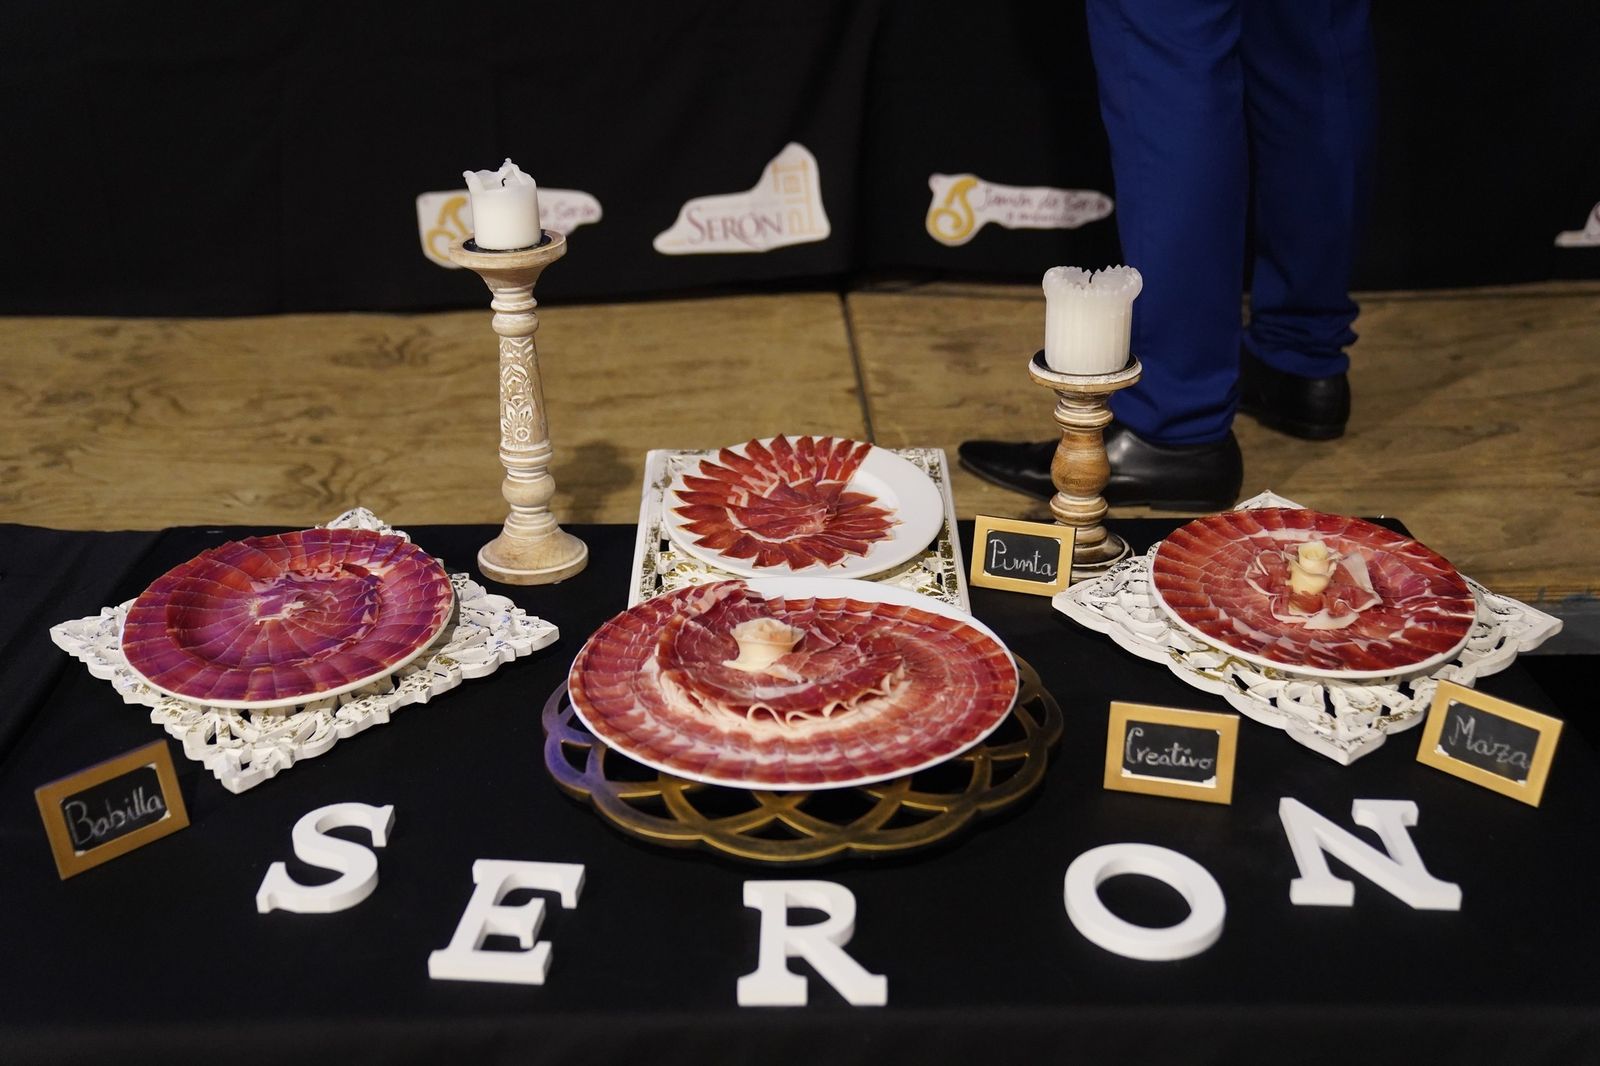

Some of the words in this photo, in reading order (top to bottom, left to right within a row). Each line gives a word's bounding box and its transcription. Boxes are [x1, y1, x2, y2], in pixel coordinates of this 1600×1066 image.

[989, 538, 1057, 577] Punta
[1125, 726, 1215, 770] Creativo
[65, 785, 164, 845] Babilla
